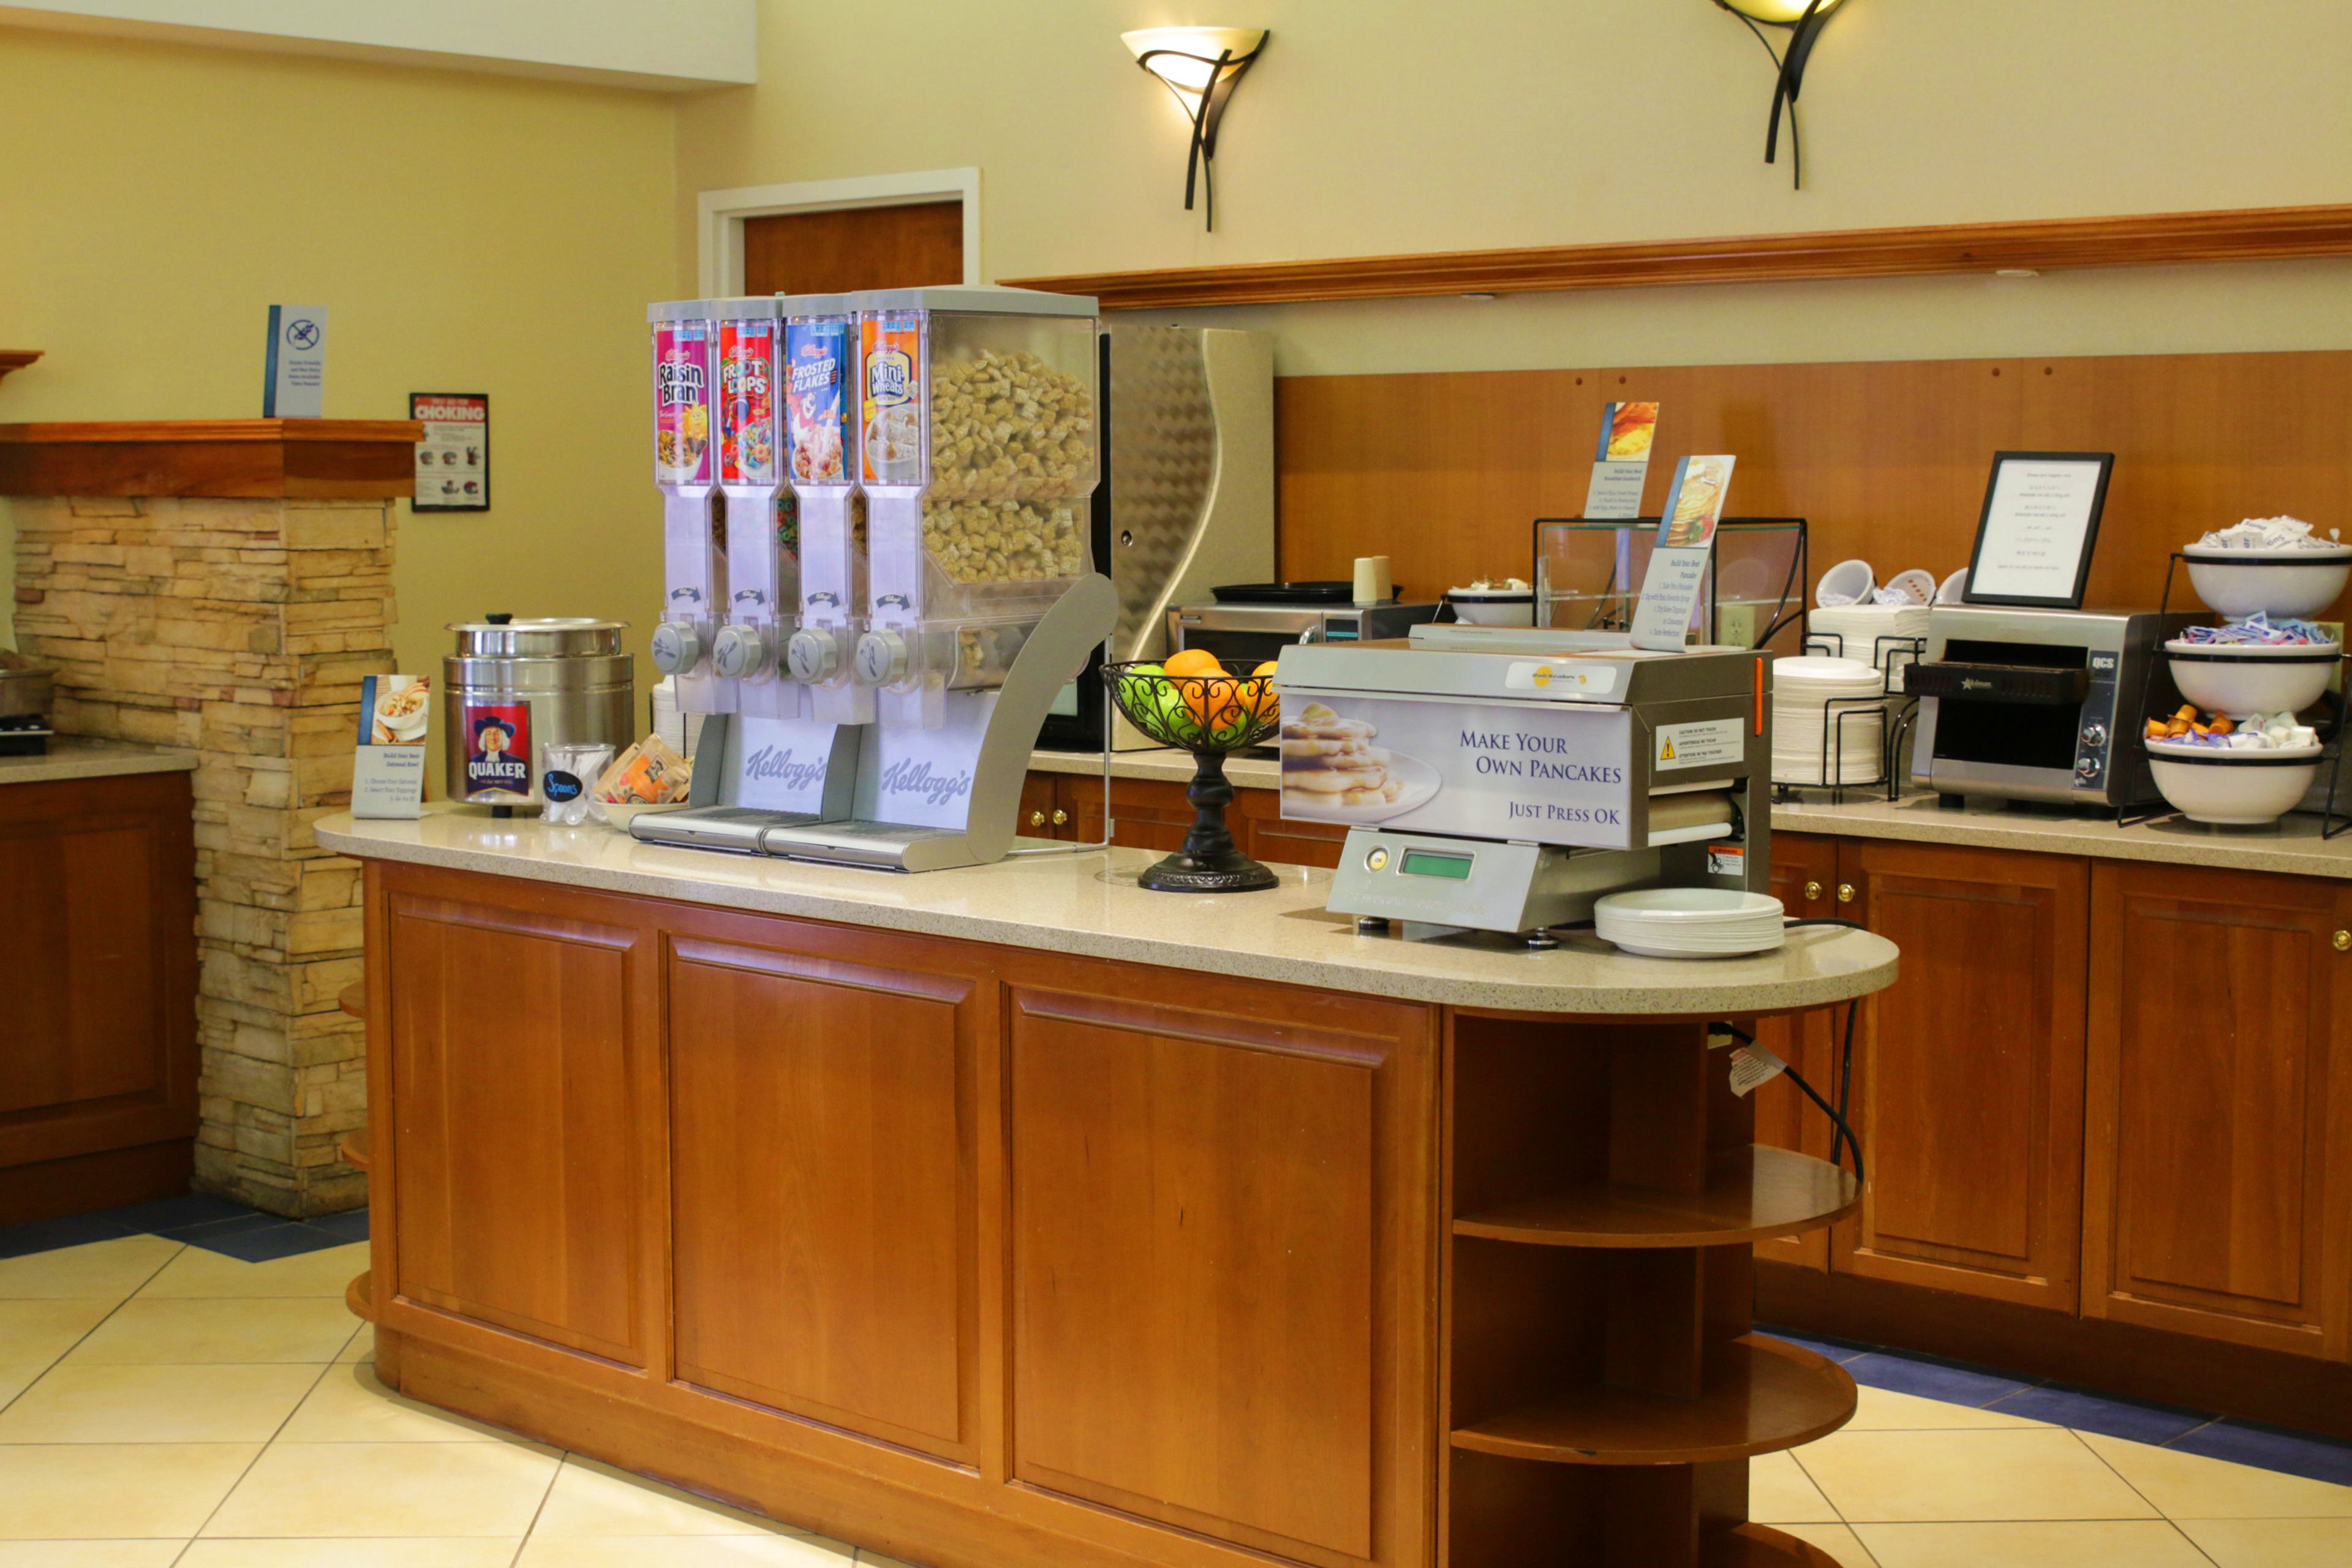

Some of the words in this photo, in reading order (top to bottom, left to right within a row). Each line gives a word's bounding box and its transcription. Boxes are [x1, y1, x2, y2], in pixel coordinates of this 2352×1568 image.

[659, 363, 704, 388] Raisin
[723, 360, 762, 383] FROOT
[791, 358, 835, 381] FROSTED
[728, 375, 766, 394] LOOPS
[793, 372, 831, 393] FLAKES
[663, 384, 699, 405] Bran
[415, 405, 485, 421] CHOKING
[2093, 657, 2114, 669] QCS
[1460, 730, 1510, 750] MAKE
[1515, 733, 1568, 755] YOUR
[469, 762, 526, 779] QUAKER
[745, 744, 827, 790] Kellogg's
[1476, 756, 1522, 776] OWN
[1530, 760, 1621, 783] PANCAKES
[548, 774, 578, 796] Spoons
[882, 757, 971, 805] Kellogg's
[1509, 801, 1542, 820] JUST
[1547, 804, 1589, 822] PRESS
[1594, 809, 1620, 824] OK
